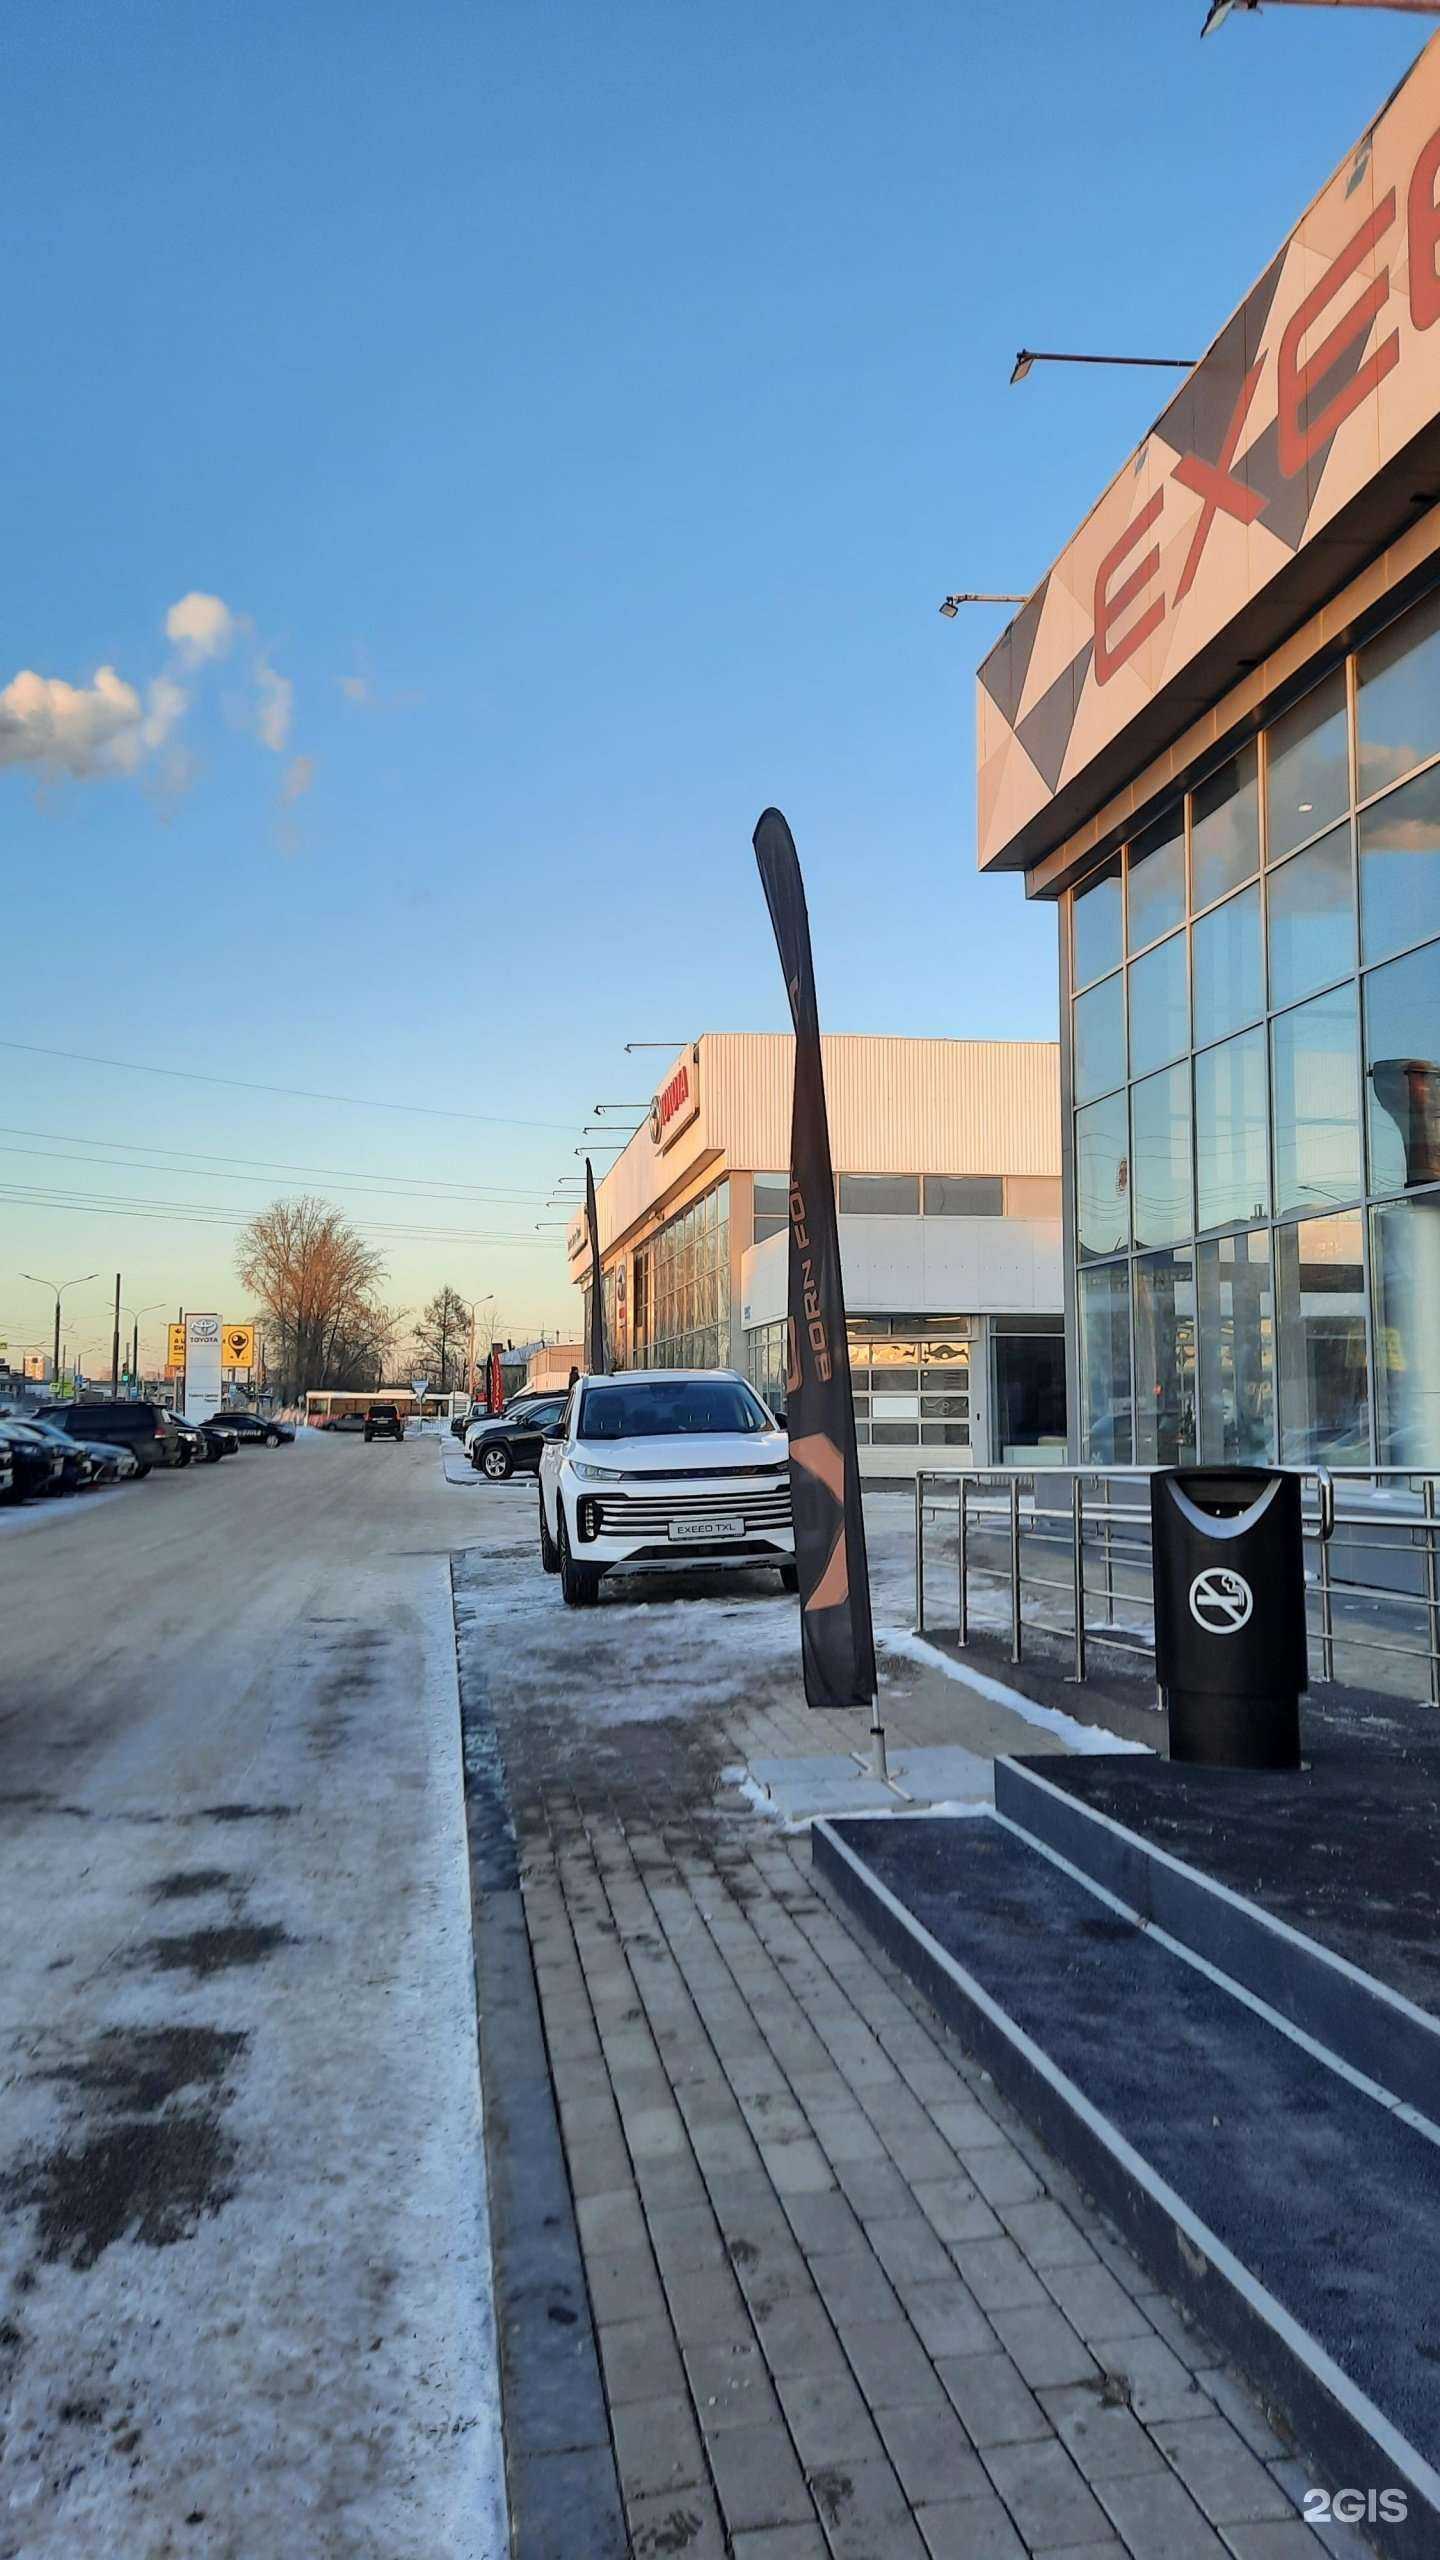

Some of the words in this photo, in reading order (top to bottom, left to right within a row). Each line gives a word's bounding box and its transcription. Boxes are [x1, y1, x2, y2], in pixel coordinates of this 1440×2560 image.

[1094, 126, 1440, 688] EXE
[677, 1524, 713, 1535] EXEED
[714, 1523, 736, 1532] TXL
